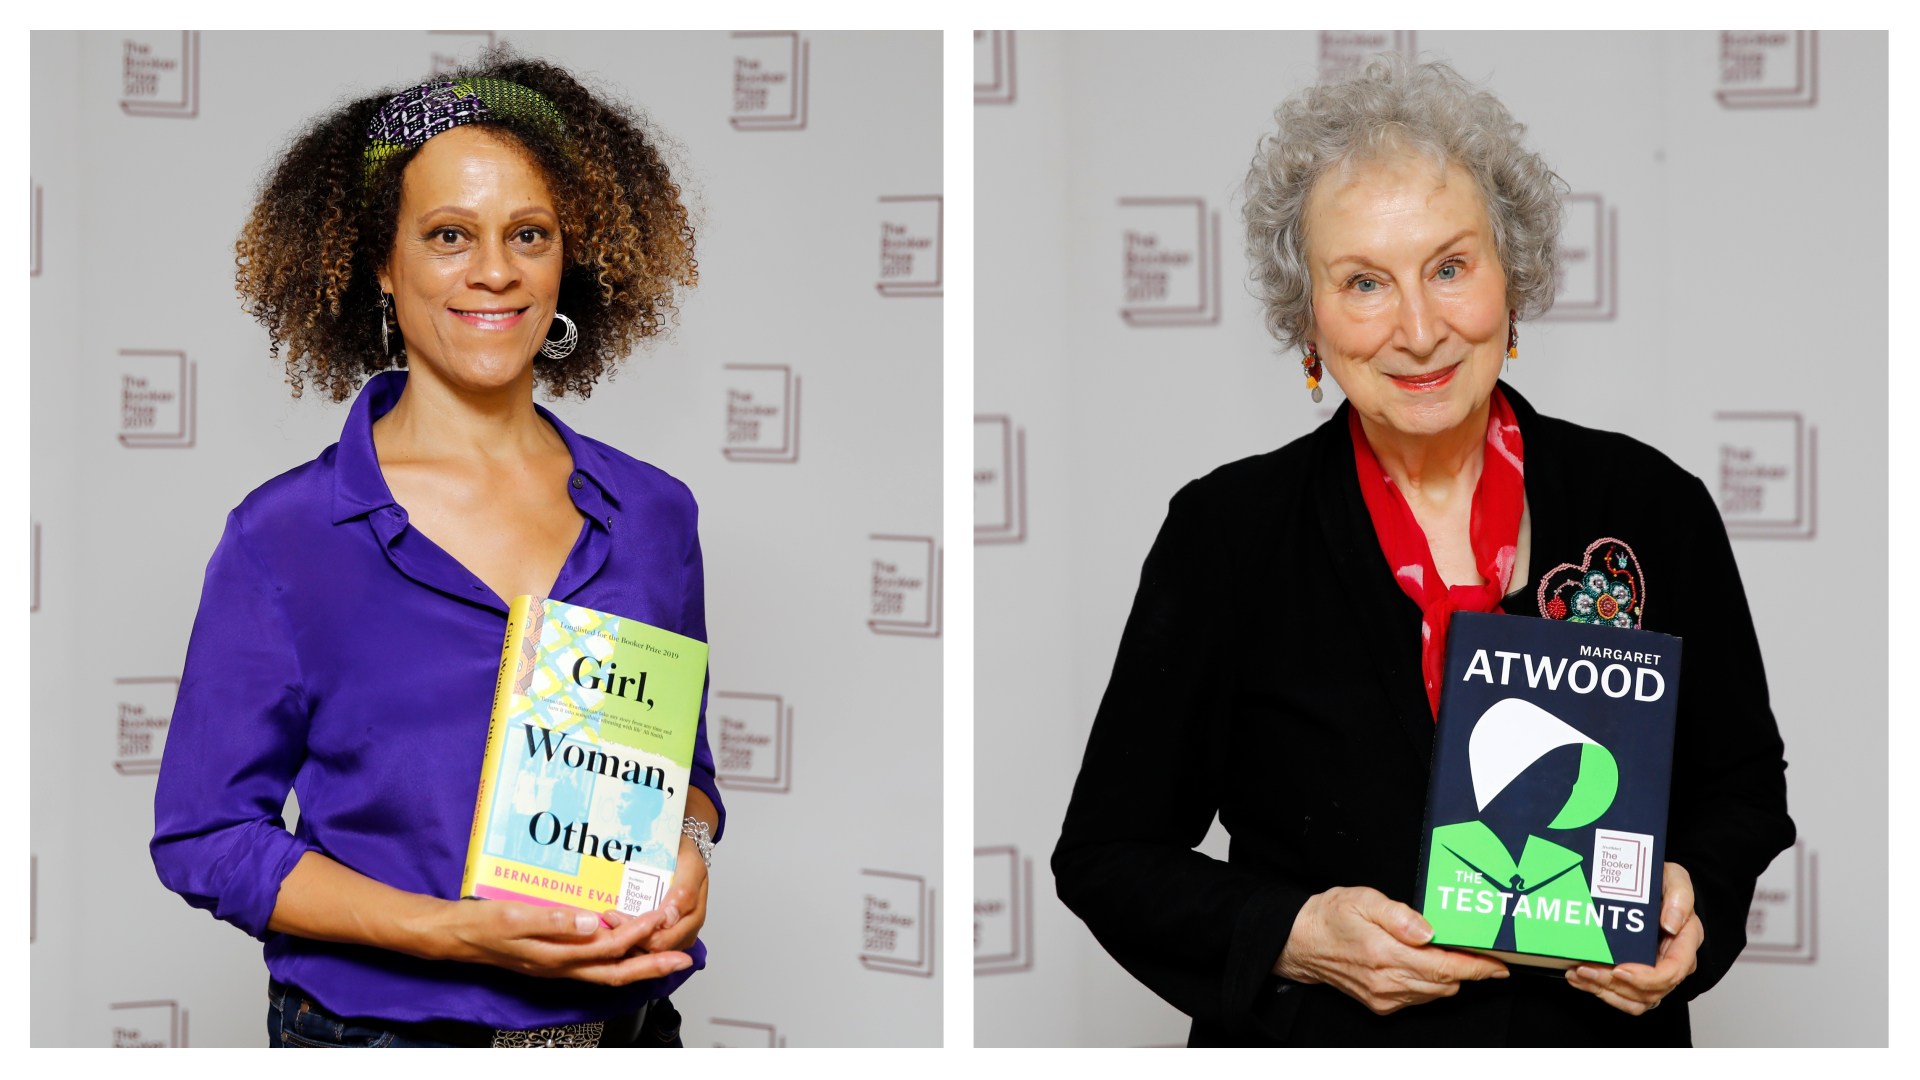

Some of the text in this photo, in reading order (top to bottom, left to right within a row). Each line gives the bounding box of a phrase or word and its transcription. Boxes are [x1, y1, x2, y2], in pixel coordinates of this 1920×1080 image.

[560, 622, 596, 636] Longlisted
[597, 631, 607, 640] for
[621, 637, 644, 650] Booker
[645, 644, 661, 655] Prize
[663, 650, 679, 660] 2019
[1579, 645, 1661, 666] MARGARET
[1462, 649, 1665, 702] ATWOOD
[572, 656, 654, 711] Girl,
[522, 722, 674, 799] Woman,
[529, 811, 642, 864] Other
[1602, 851, 1617, 860] The
[1601, 859, 1633, 870] Booker
[1455, 870, 1483, 884] THE
[1600, 874, 1620, 883] 2019
[1601, 867, 1621, 877] Prize
[494, 865, 583, 897] BERNARDINE
[628, 881, 640, 891] The
[625, 896, 641, 906] Prize
[626, 888, 651, 902] Booker
[623, 903, 640, 913] 2019
[1437, 886, 1645, 933] TESTAMENTS
